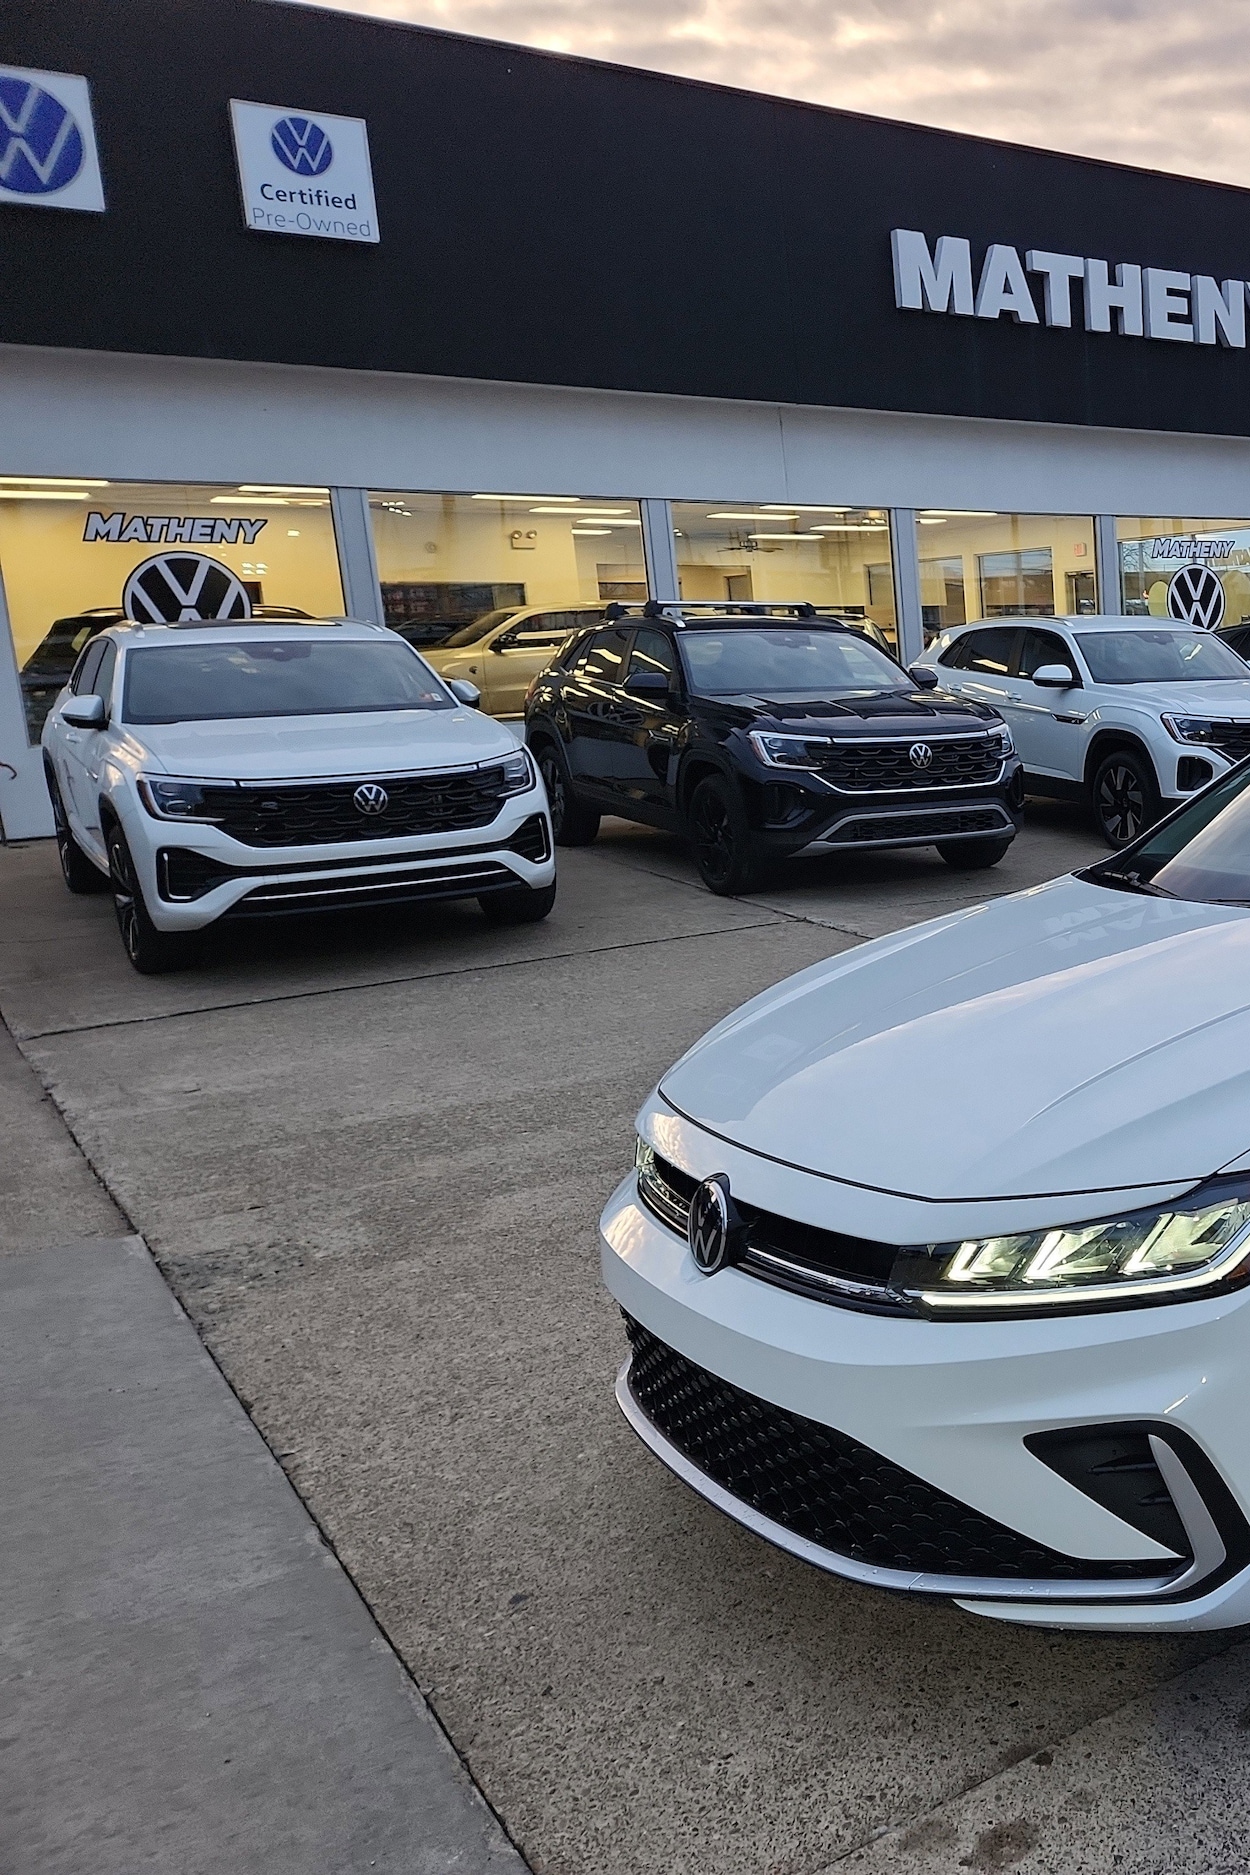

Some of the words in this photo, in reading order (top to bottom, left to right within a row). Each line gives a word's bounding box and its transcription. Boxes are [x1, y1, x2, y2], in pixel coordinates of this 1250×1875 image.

[271, 117, 333, 176] VW
[260, 183, 357, 210] Certified
[252, 207, 371, 237] Pre-Owned
[83, 512, 268, 544] MATHENY
[1152, 538, 1235, 558] MATHENY
[1167, 563, 1225, 632] VW
[909, 743, 933, 769] VW
[353, 784, 388, 815] VW
